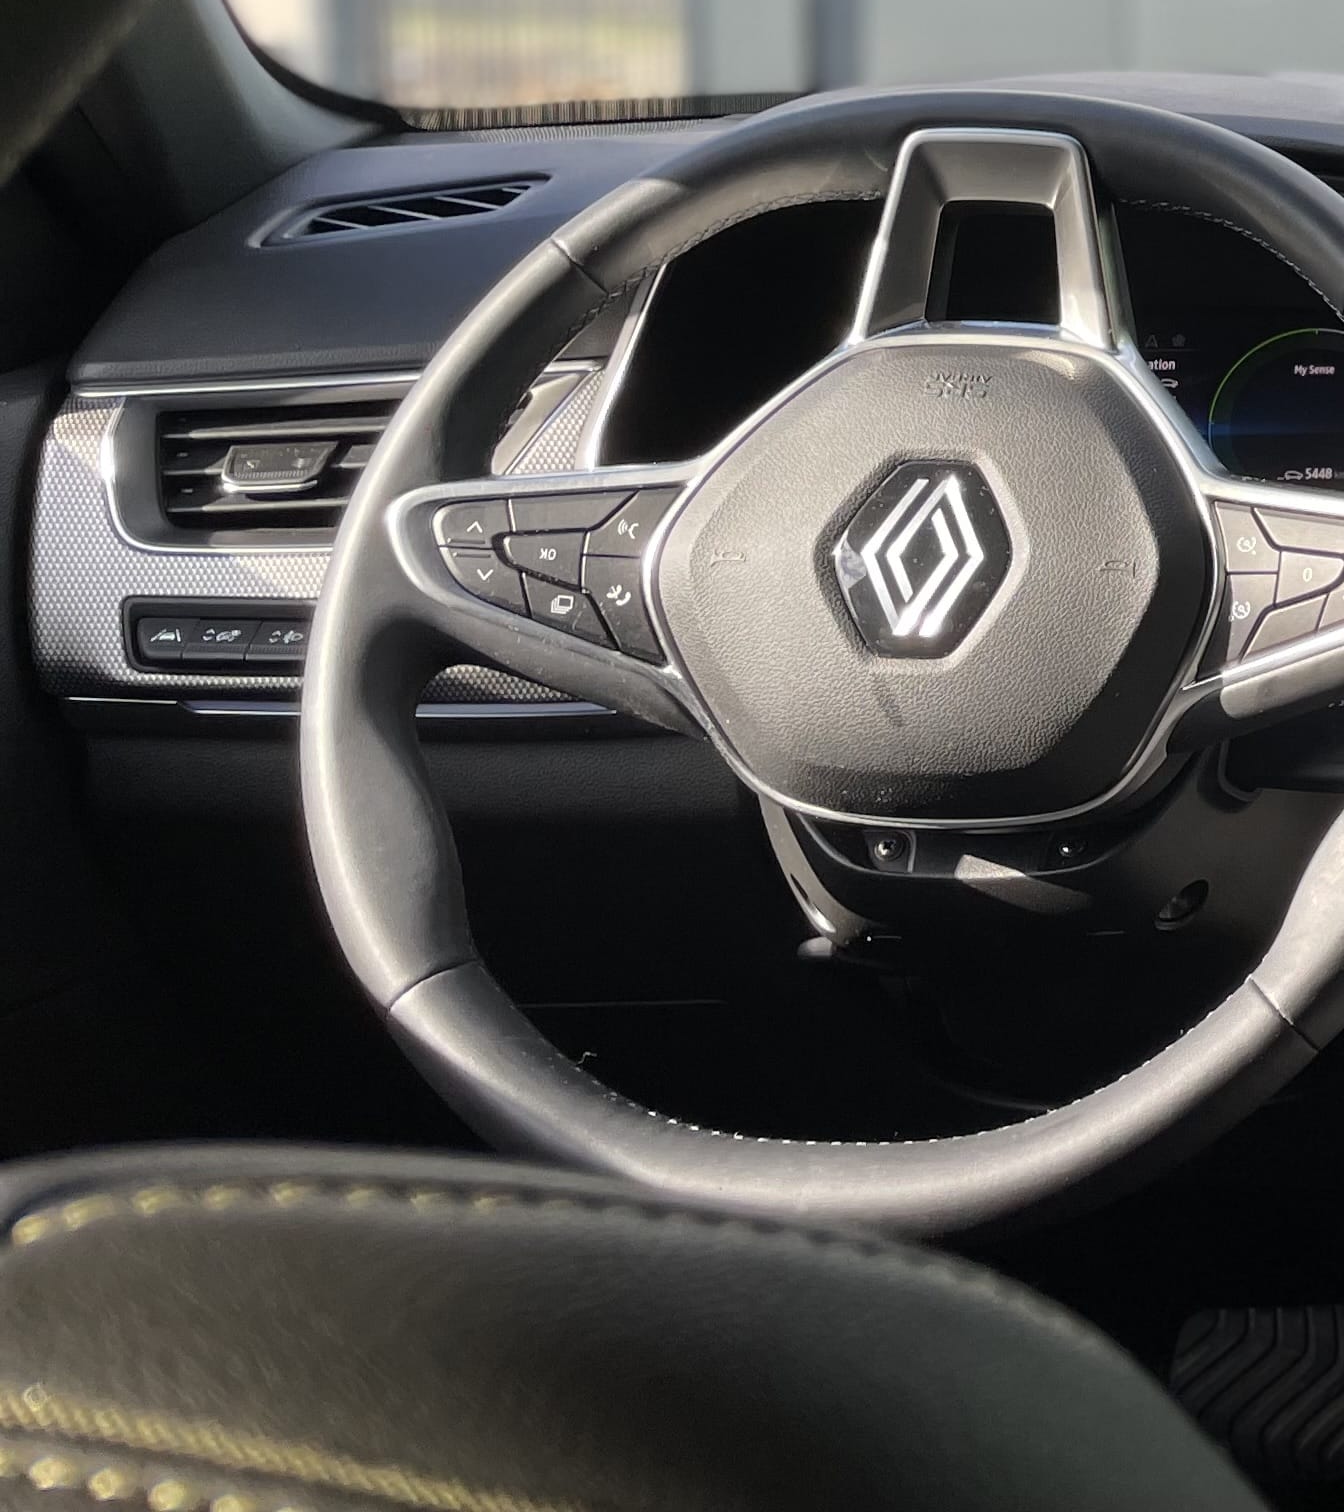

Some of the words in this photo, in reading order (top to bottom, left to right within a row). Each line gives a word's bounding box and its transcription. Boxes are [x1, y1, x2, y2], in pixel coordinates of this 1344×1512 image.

[1294, 364, 1308, 377] My
[1309, 364, 1335, 375] Sense
[1305, 467, 1333, 480] 5448
[539, 546, 558, 561] OK
